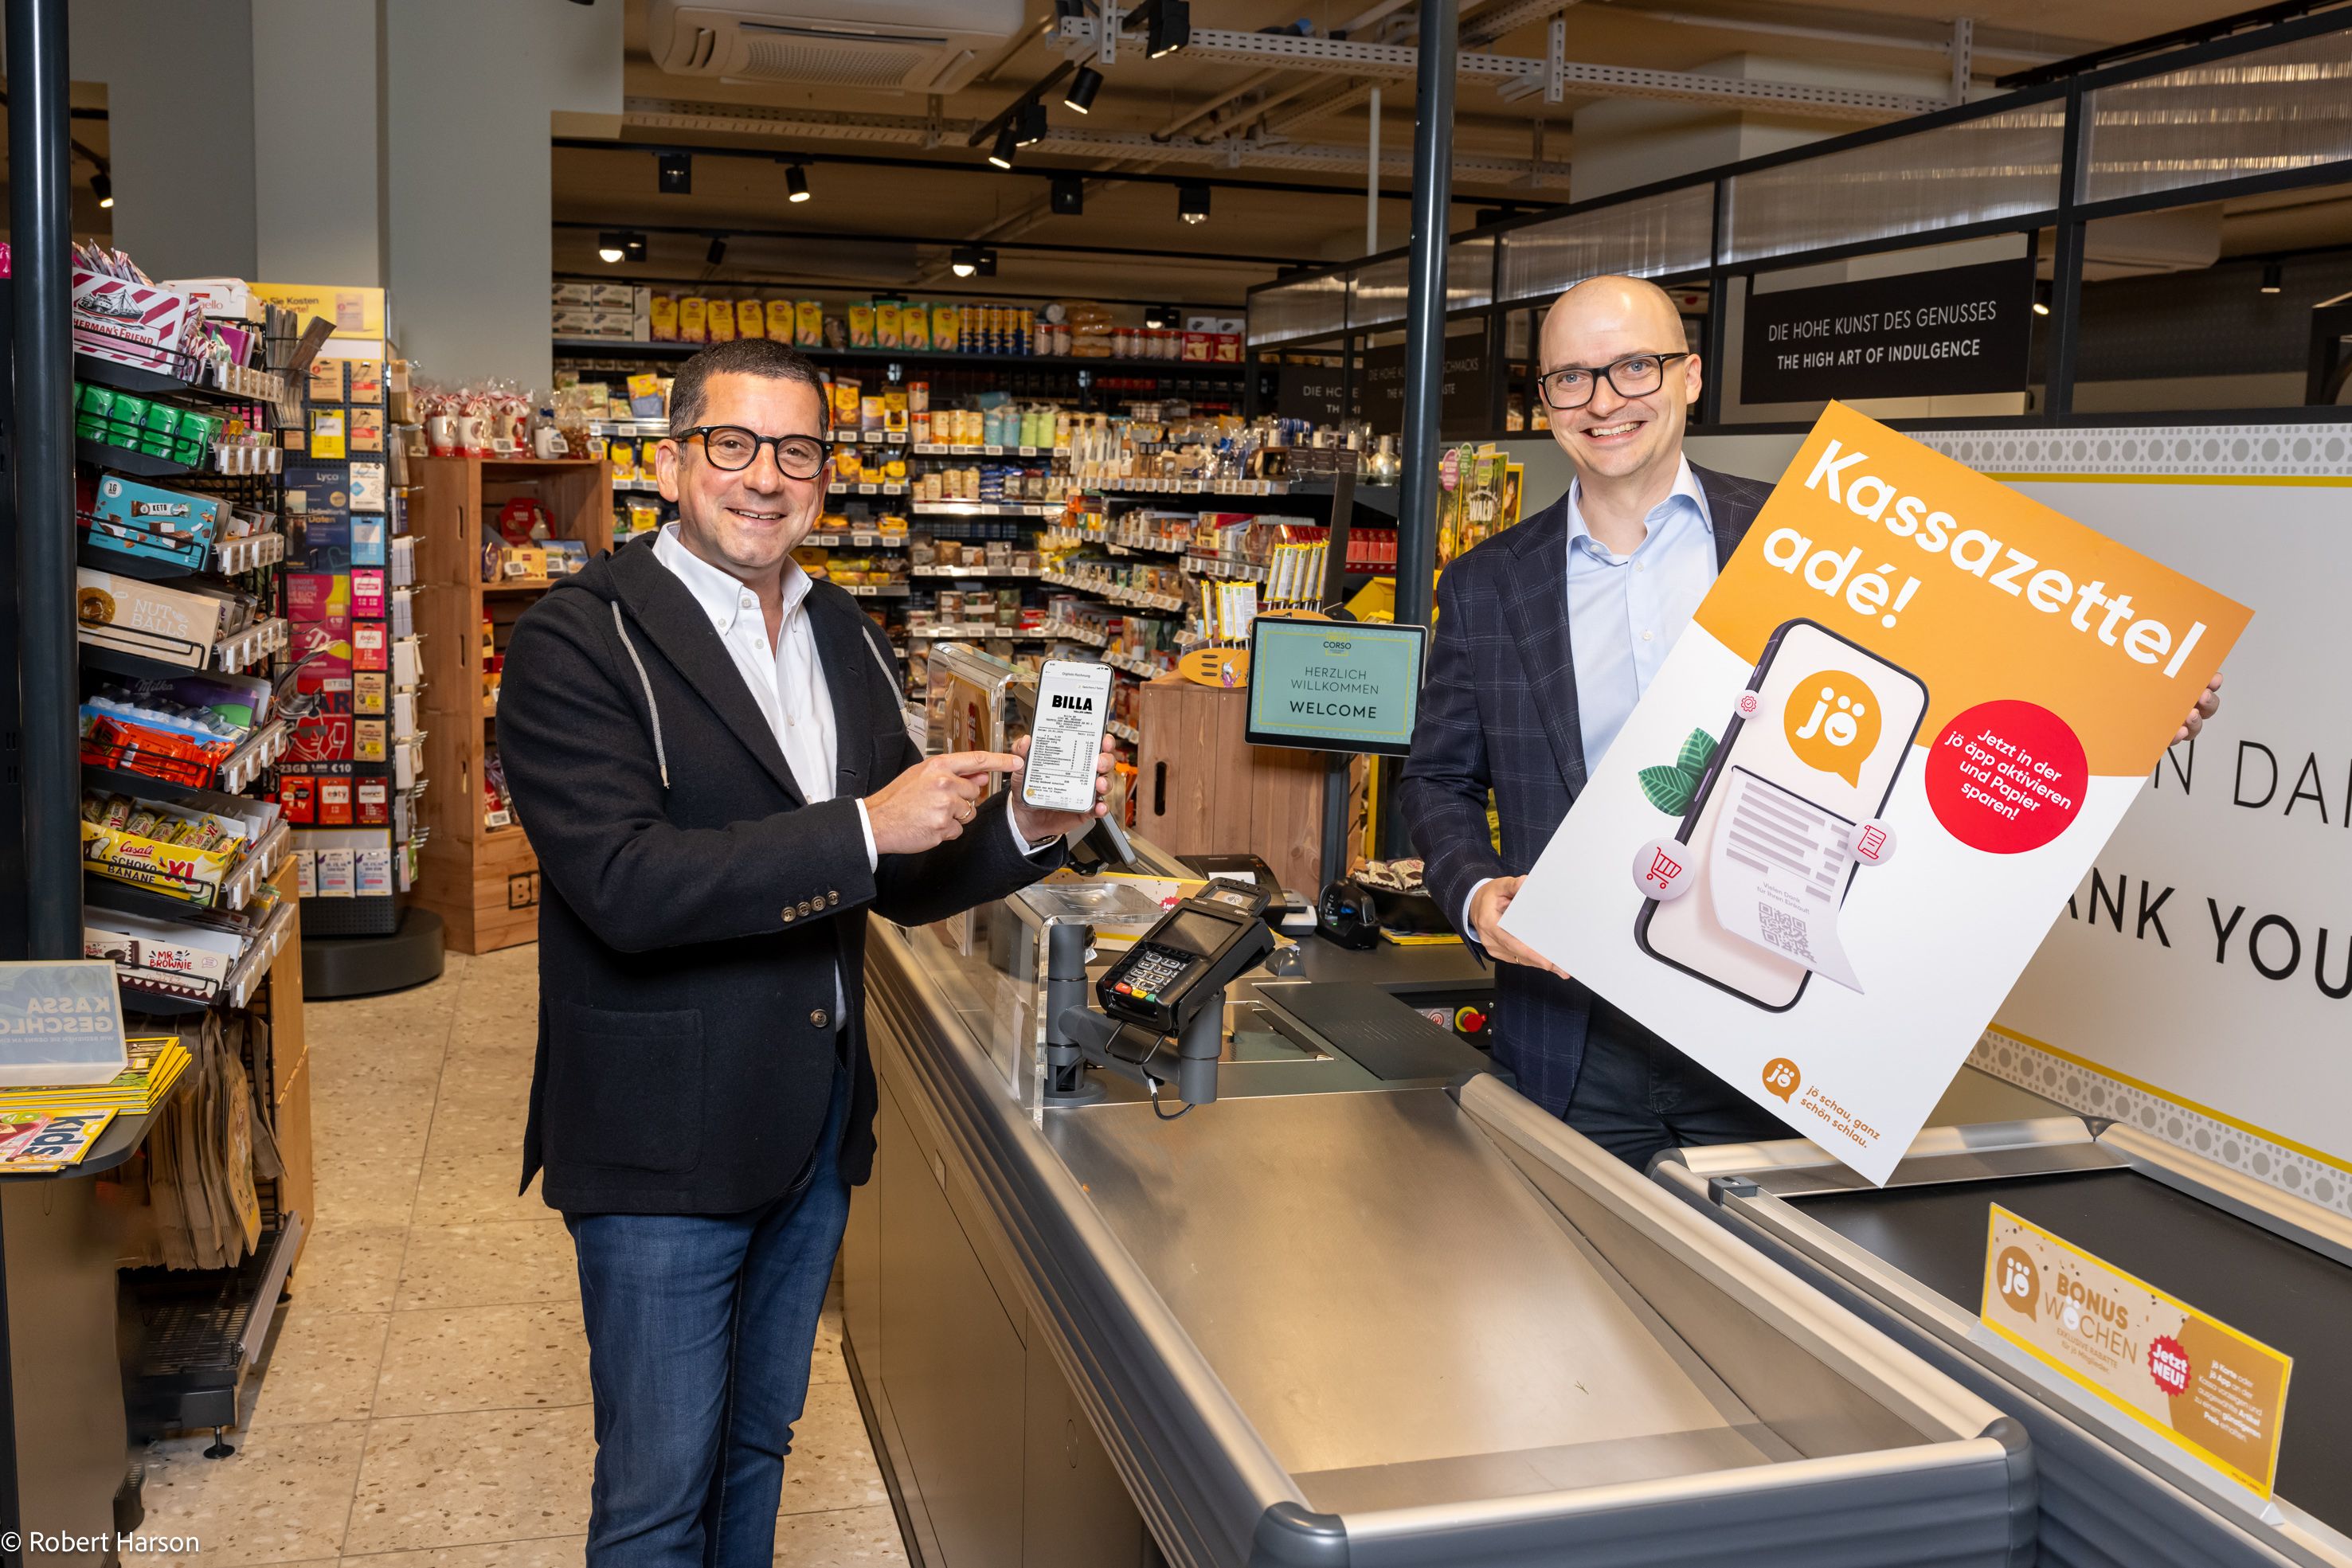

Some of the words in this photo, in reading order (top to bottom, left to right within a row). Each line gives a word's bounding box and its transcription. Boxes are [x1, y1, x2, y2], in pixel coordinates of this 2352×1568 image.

[287, 296, 319, 305] Kosten
[1768, 323, 1789, 342] DIE
[1793, 318, 1830, 339] HOHE
[1834, 313, 1880, 335] KUNST
[1884, 310, 1912, 330] DES
[1916, 300, 1997, 327] GENUSSES
[119, 327, 155, 346] FRIEND
[1777, 354, 1799, 370] THE
[1802, 351, 1834, 368] HIGH
[1837, 349, 1862, 366] ART
[1865, 347, 1885, 364] OF
[1888, 338, 1981, 362] INDULGENCE
[1303, 385, 1321, 397] DIE
[1469, 500, 1493, 522] WALD
[1804, 439, 2208, 679] Kassazettel
[1763, 527, 1922, 629] adé!
[134, 599, 172, 620] NUT
[131, 614, 189, 638] BALLS
[1323, 641, 1352, 650] CORSO
[1305, 666, 1367, 680] HERZLICH
[135, 679, 174, 692] Milka
[1290, 678, 1379, 695] WILLKOMMEN
[1051, 694, 1093, 711] BILLA
[1289, 700, 1377, 719] WELCOME
[1795, 686, 1866, 747] jö
[331, 763, 352, 773] €10
[1977, 729, 2017, 758] Jetzt
[2016, 749, 2033, 767] in
[2033, 761, 2062, 783] der
[1944, 731, 1964, 747] jö
[1964, 741, 1995, 766] äpp
[1997, 761, 2072, 810] aktivieren
[1959, 761, 1991, 784] und
[1990, 776, 2041, 811] Papier
[1961, 782, 2020, 821] sparen!
[119, 840, 155, 855] Casali
[108, 865, 156, 884] BANANE
[164, 859, 198, 885] XL
[1756, 886, 1767, 895] für
[1767, 889, 1784, 902] Ihren
[1763, 881, 1783, 896] Vielen
[1783, 891, 1801, 904] Dank
[157, 950, 174, 961] MR
[2206, 897, 2352, 999] YOU
[1765, 1063, 1795, 1088] jö
[1800, 1097, 1831, 1123] schön
[1831, 1118, 1868, 1148] schlau.
[1806, 1085, 1820, 1097] jö
[1819, 1094, 1852, 1123] schau,
[1853, 1118, 1880, 1140] ganz
[2002, 1257, 2030, 1298] jö
[2057, 1272, 2129, 1330] BONUS
[2152, 1343, 2188, 1374] Jetzt
[2153, 1359, 2186, 1390] NEU!
